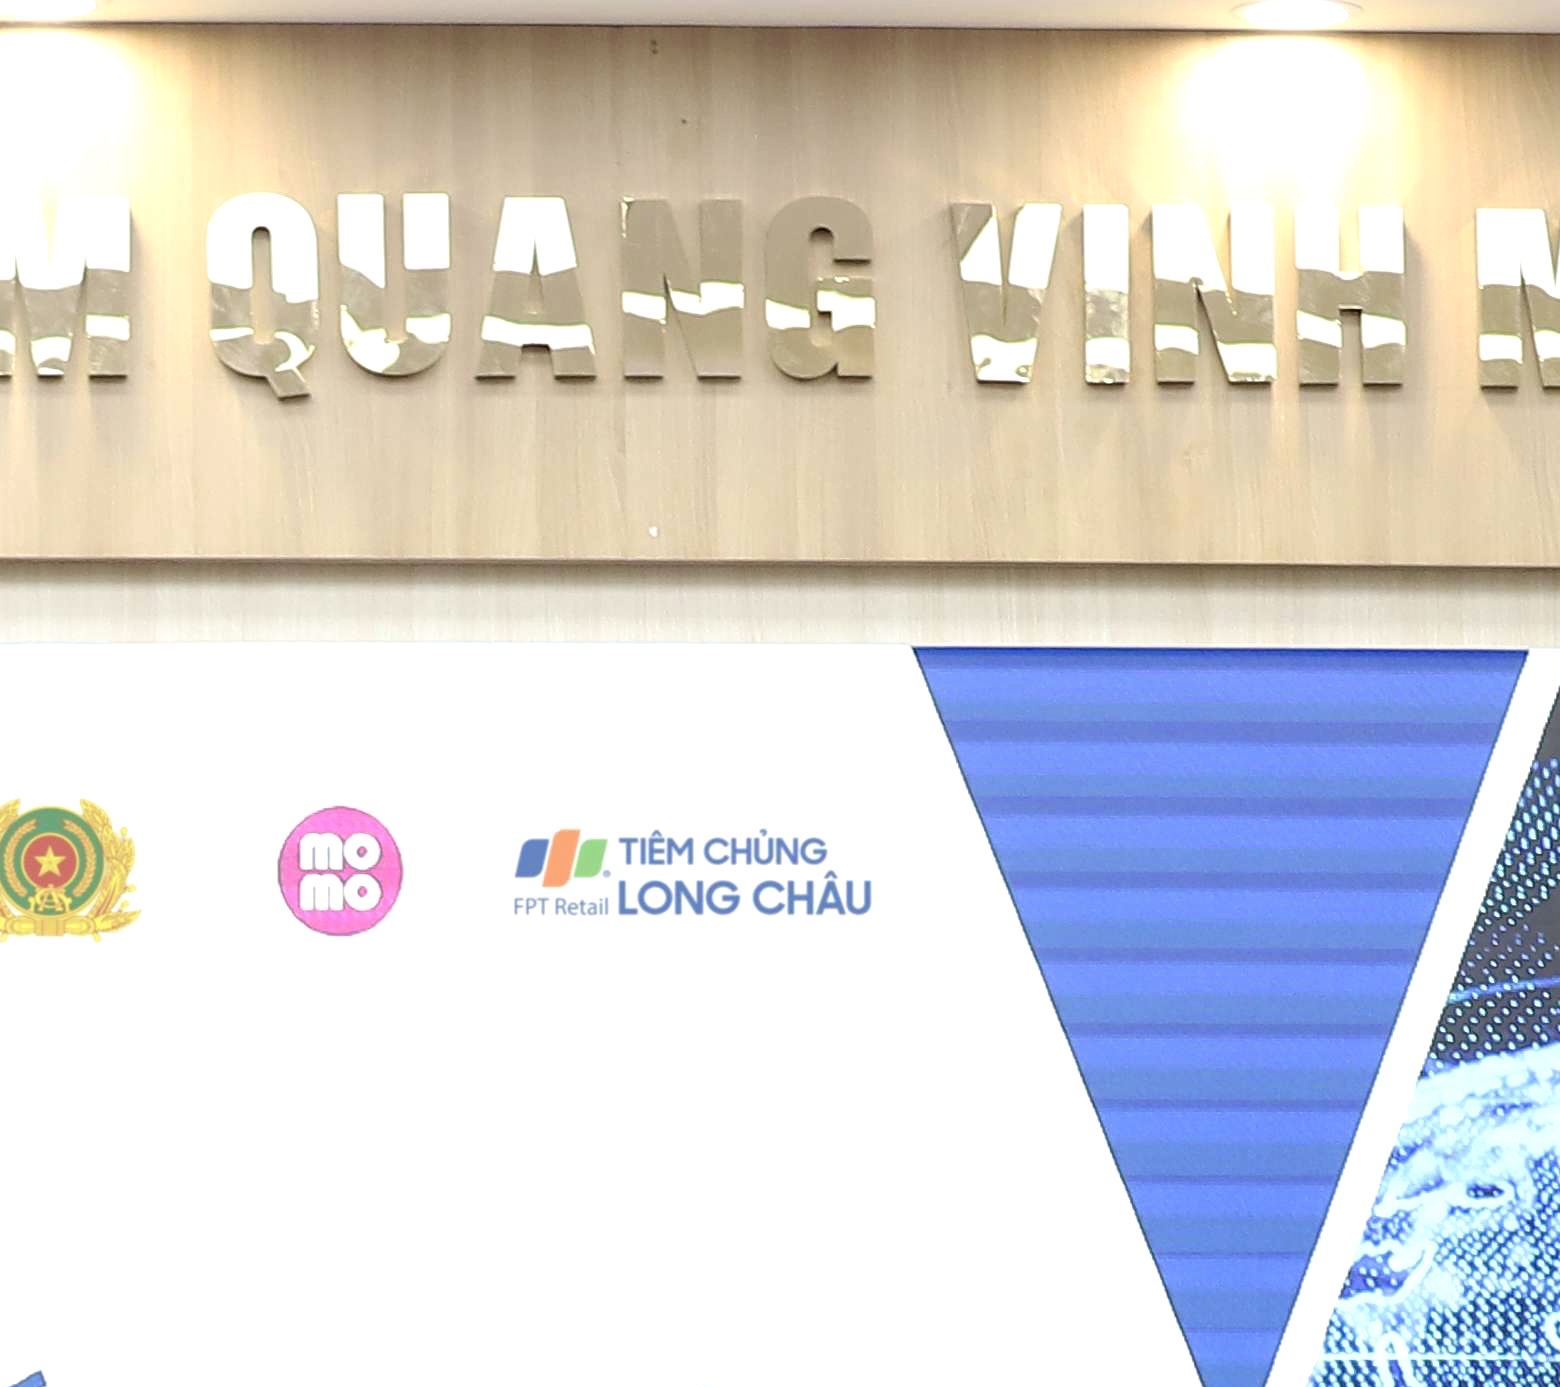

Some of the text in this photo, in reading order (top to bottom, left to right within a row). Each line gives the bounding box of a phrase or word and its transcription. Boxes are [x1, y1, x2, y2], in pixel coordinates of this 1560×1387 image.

[205, 190, 874, 400] QUANG
[948, 200, 1406, 389] VINH
[617, 827, 829, 866] TIÊM CHỦNG
[513, 896, 609, 916] FPT Retail
[617, 869, 873, 916] LONG CHÂU
